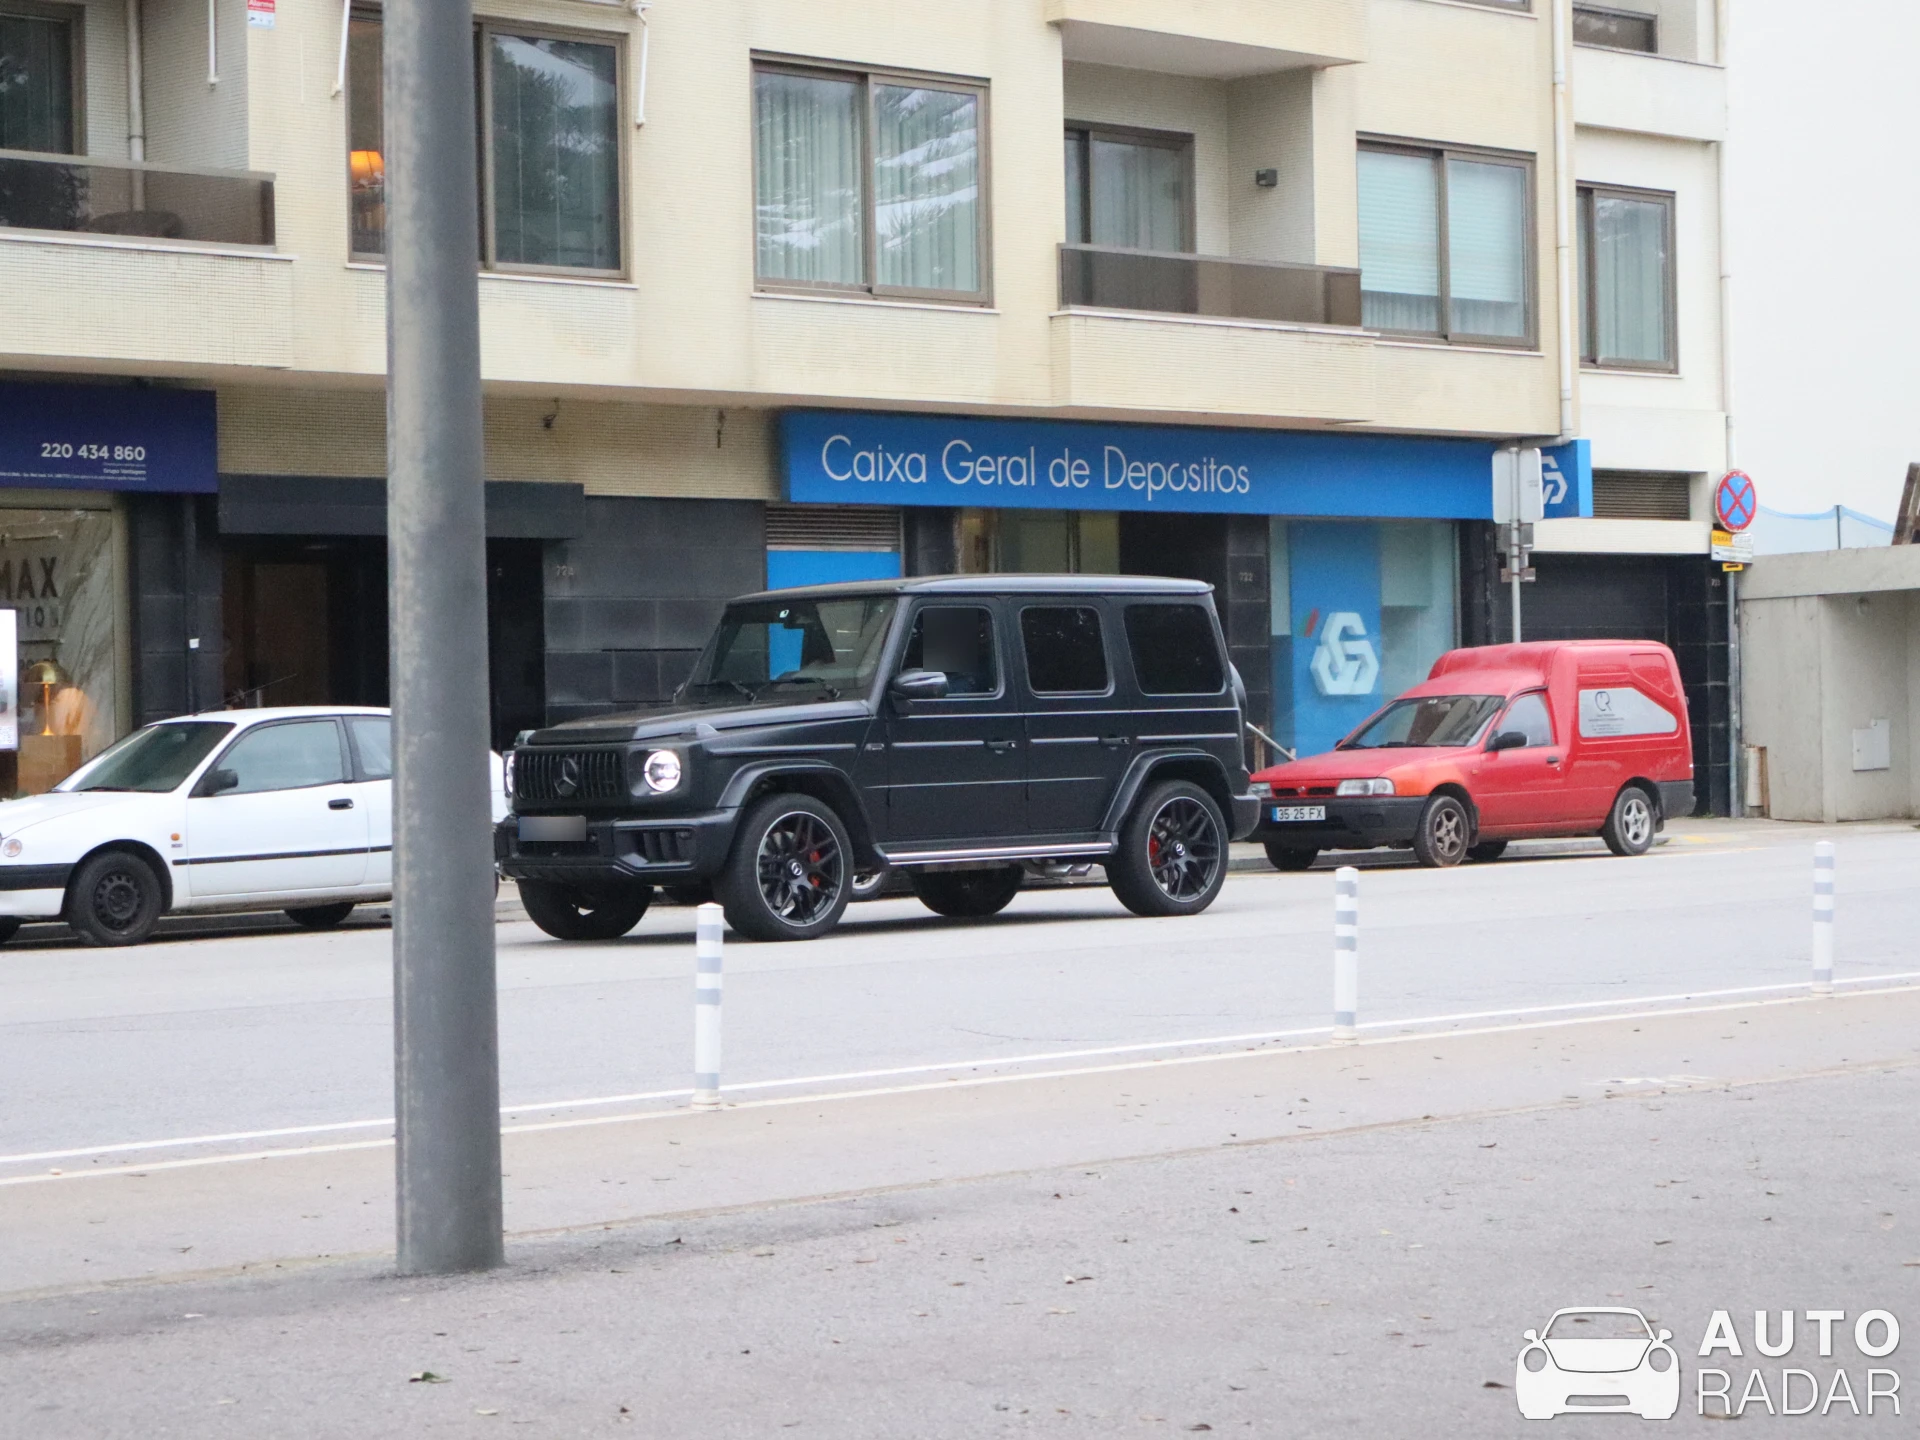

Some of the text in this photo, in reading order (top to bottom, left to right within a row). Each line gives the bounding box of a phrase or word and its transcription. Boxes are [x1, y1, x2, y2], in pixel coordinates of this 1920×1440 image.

[41, 443, 146, 460] 220 434 860
[822, 434, 1250, 501] Caixa Geral de Depositos
[1278, 807, 1323, 819] 35 25 FX
